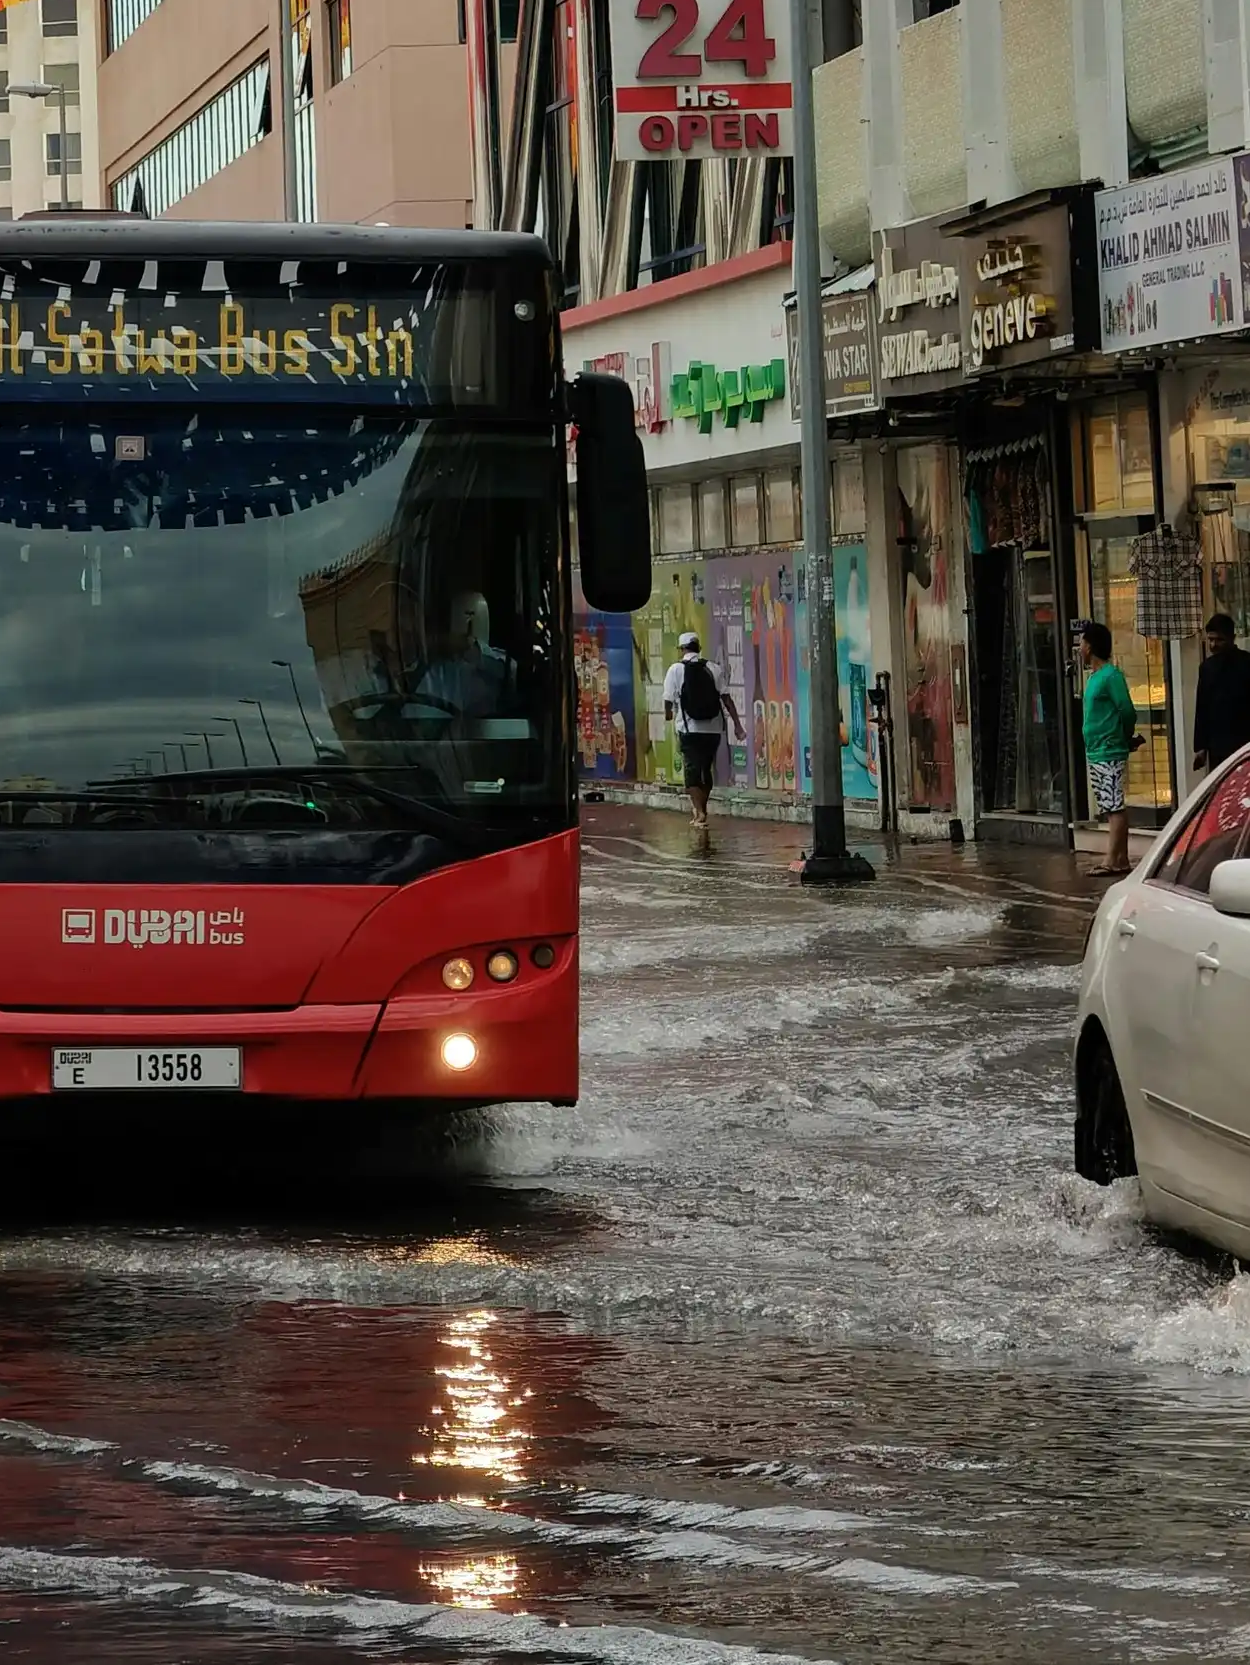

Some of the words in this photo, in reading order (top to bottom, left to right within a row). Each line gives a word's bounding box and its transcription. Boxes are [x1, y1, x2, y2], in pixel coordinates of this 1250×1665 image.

[676, 85, 739, 109] Hrs.
[638, 113, 781, 152] OPEN
[1100, 232, 1140, 270] KHALID
[1143, 220, 1182, 259] AHMAD
[1185, 209, 1231, 249] SALMIN
[47, 302, 198, 376] Satwa
[220, 302, 309, 376] Bus
[330, 302, 412, 376] Stn
[842, 343, 869, 377] STAR
[104, 909, 205, 947] DUBAI
[209, 907, 245, 927] باص
[209, 929, 245, 945] bus
[73, 1067, 85, 1085] E
[136, 1053, 202, 1082] 13558
